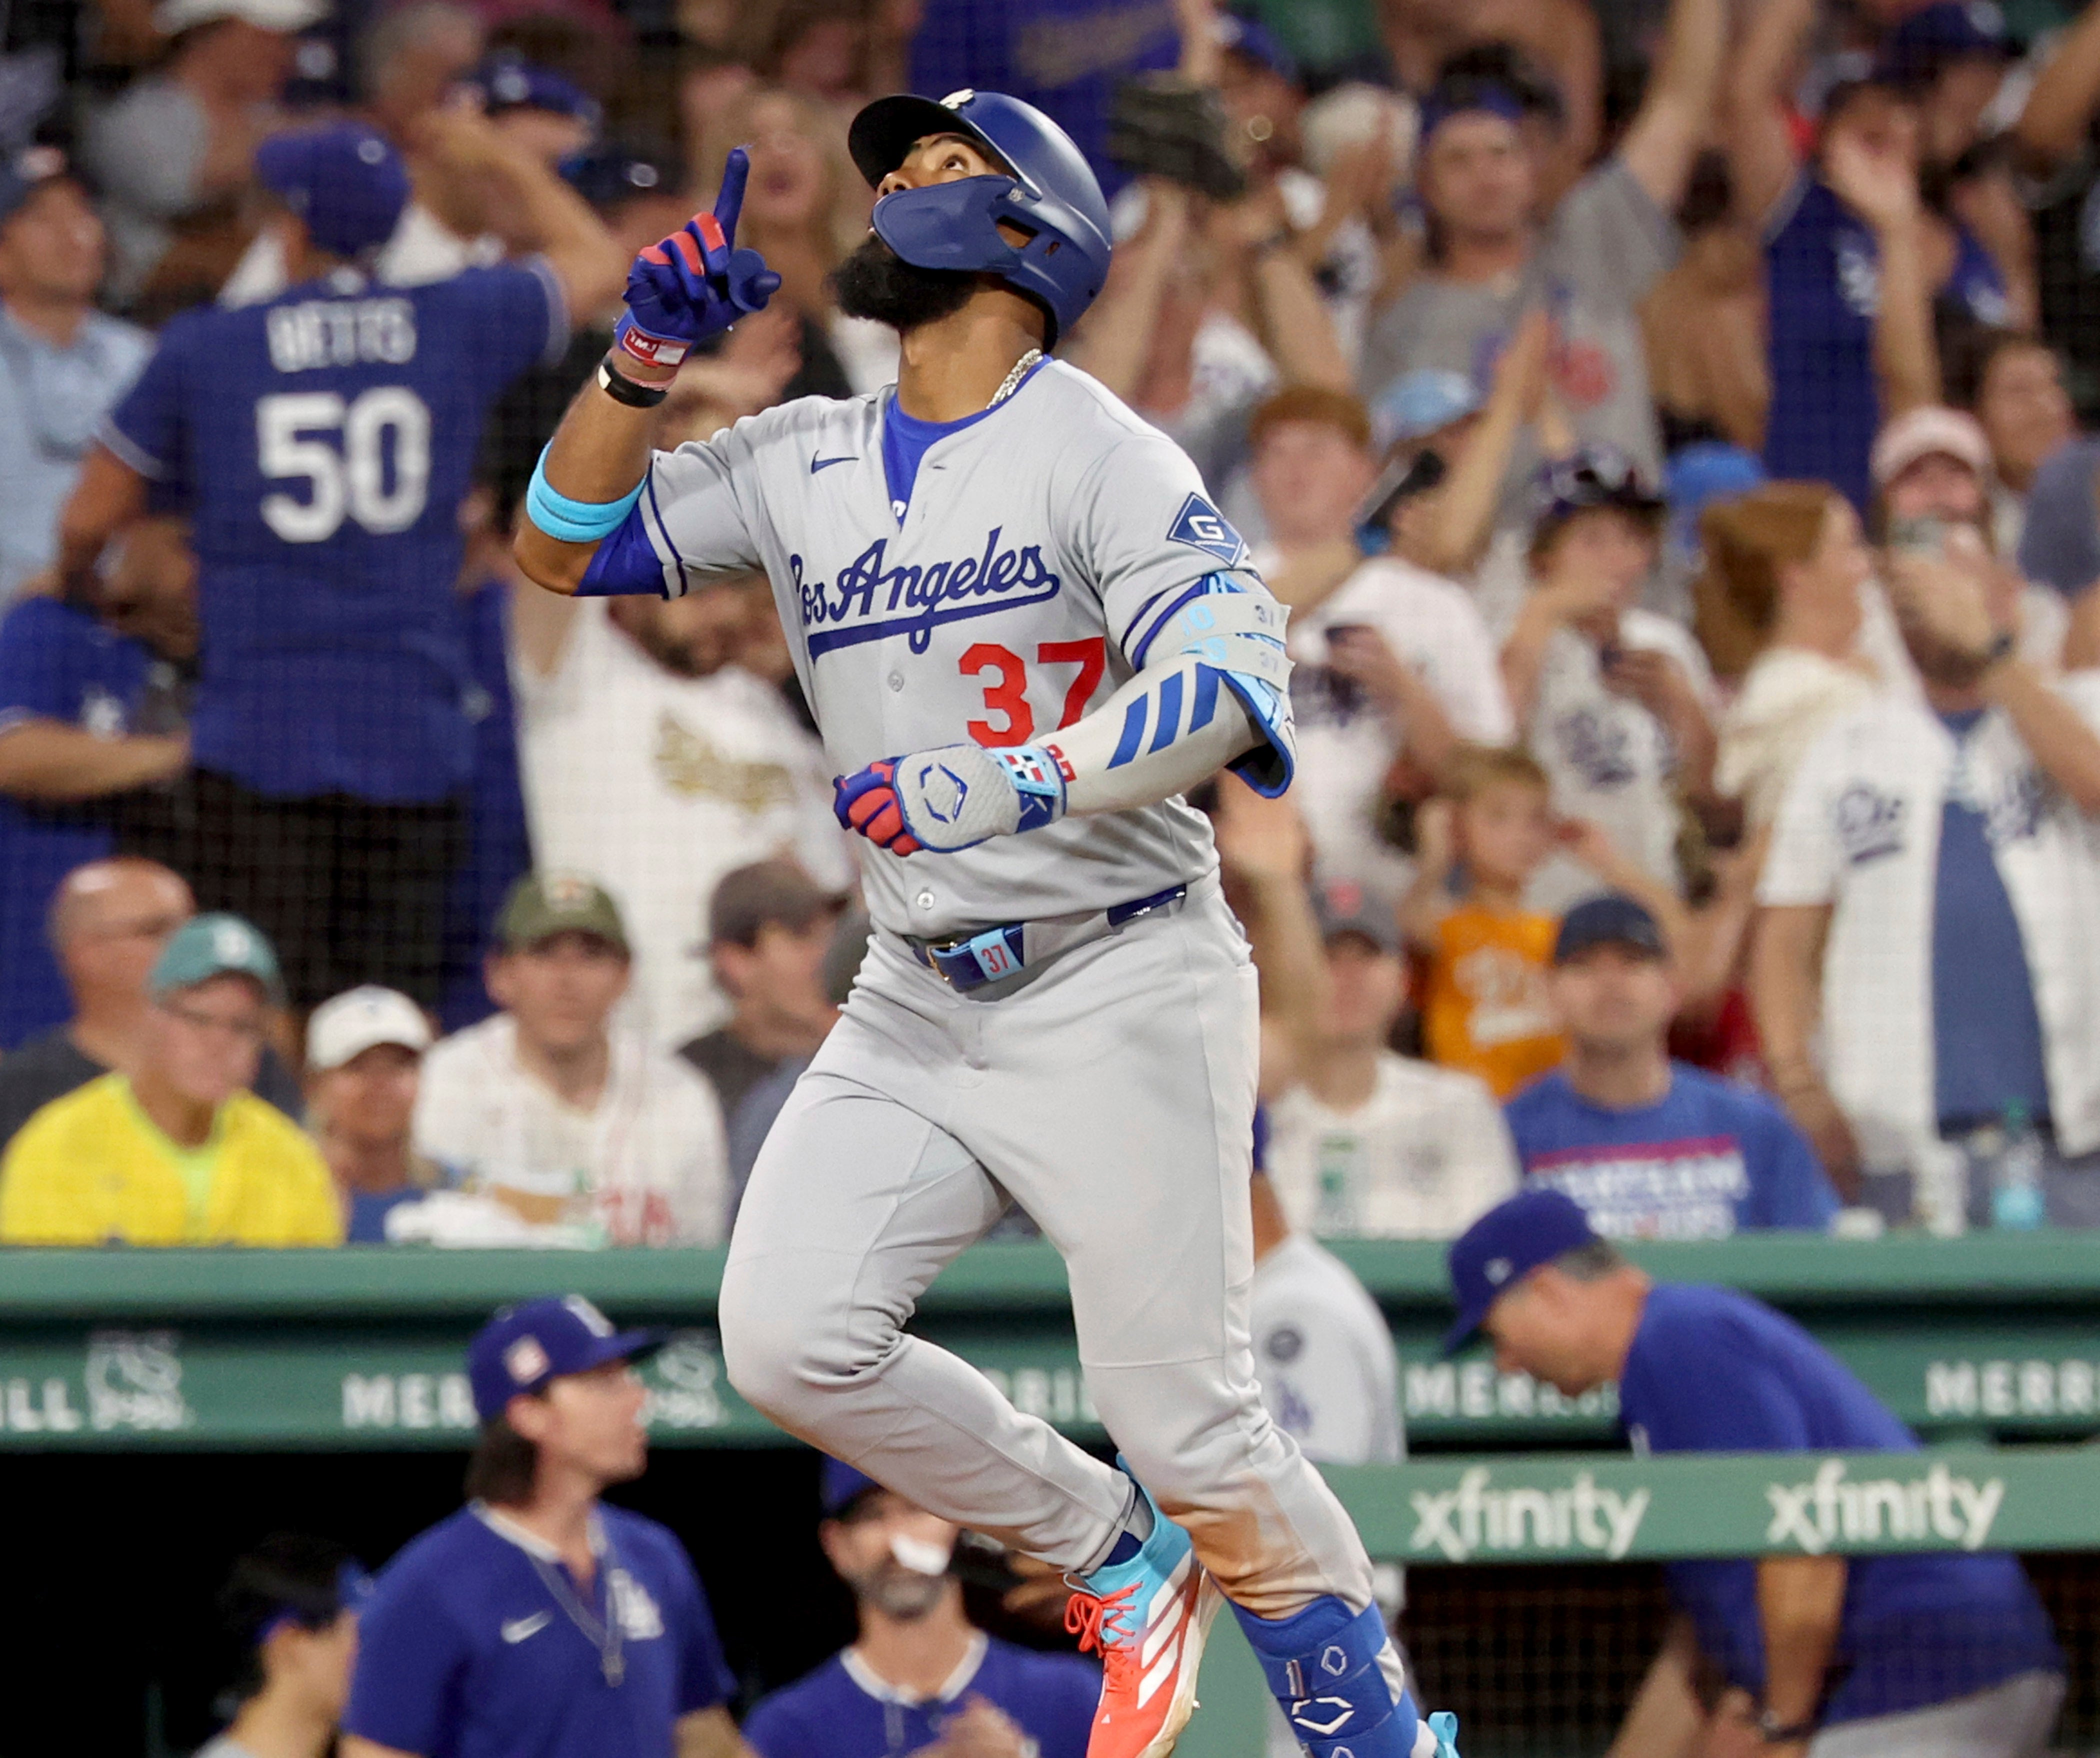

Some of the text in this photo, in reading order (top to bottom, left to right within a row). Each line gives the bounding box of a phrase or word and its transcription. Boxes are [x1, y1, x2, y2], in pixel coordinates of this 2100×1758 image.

[256, 385, 432, 543] 50
[1188, 516, 1224, 540] G
[829, 526, 1060, 654] Angeles
[958, 636, 1106, 749] 37
[981, 944, 1009, 973] 37
[0, 1378, 82, 1432] LL
[1926, 1359, 2100, 1417] MERR
[1410, 1466, 1650, 1563] xfinity
[1766, 1458, 2005, 1555] xfinity
